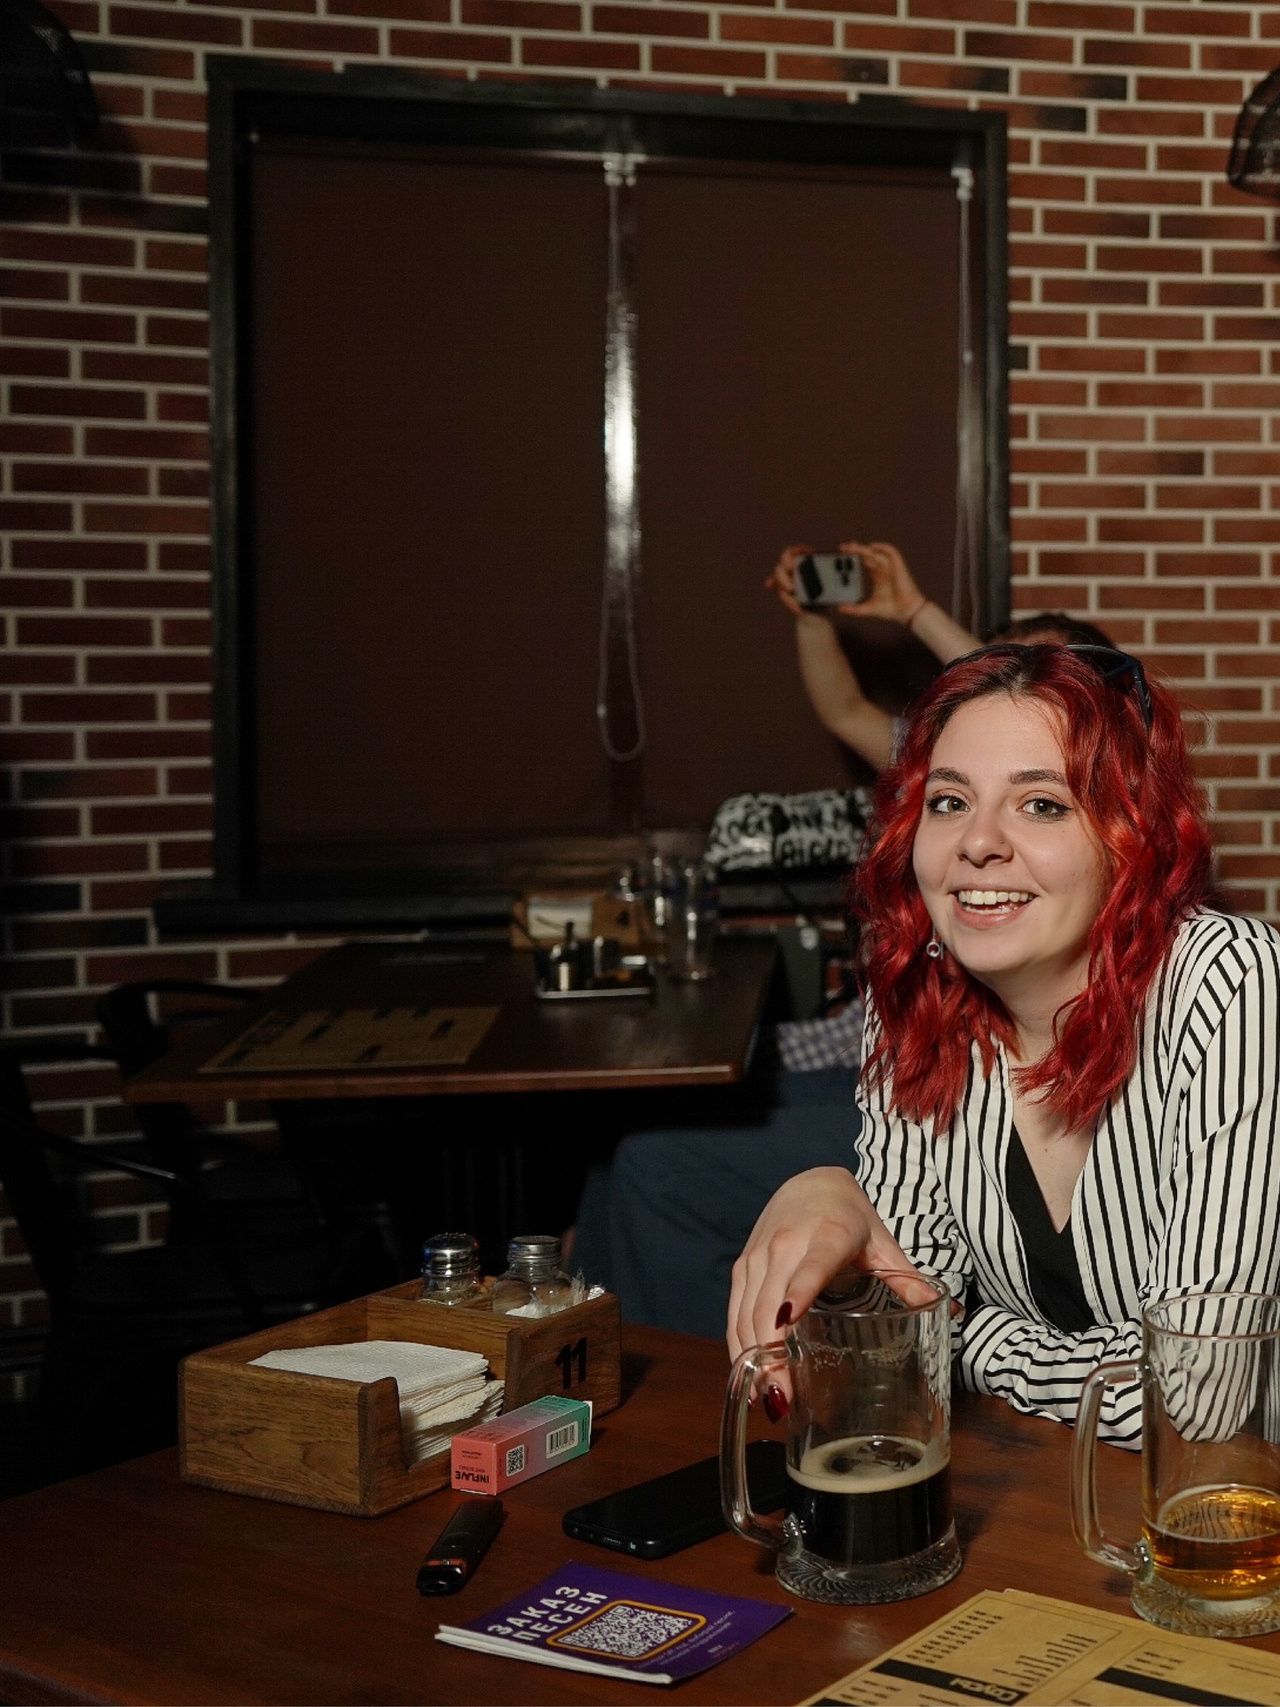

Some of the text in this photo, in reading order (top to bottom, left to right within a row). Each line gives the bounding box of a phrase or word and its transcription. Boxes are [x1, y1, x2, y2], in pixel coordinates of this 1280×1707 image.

[555, 1337, 587, 1390] 11
[487, 1586, 580, 1635] ЗАКАЗ
[512, 1592, 608, 1641] ПЕСЕН
